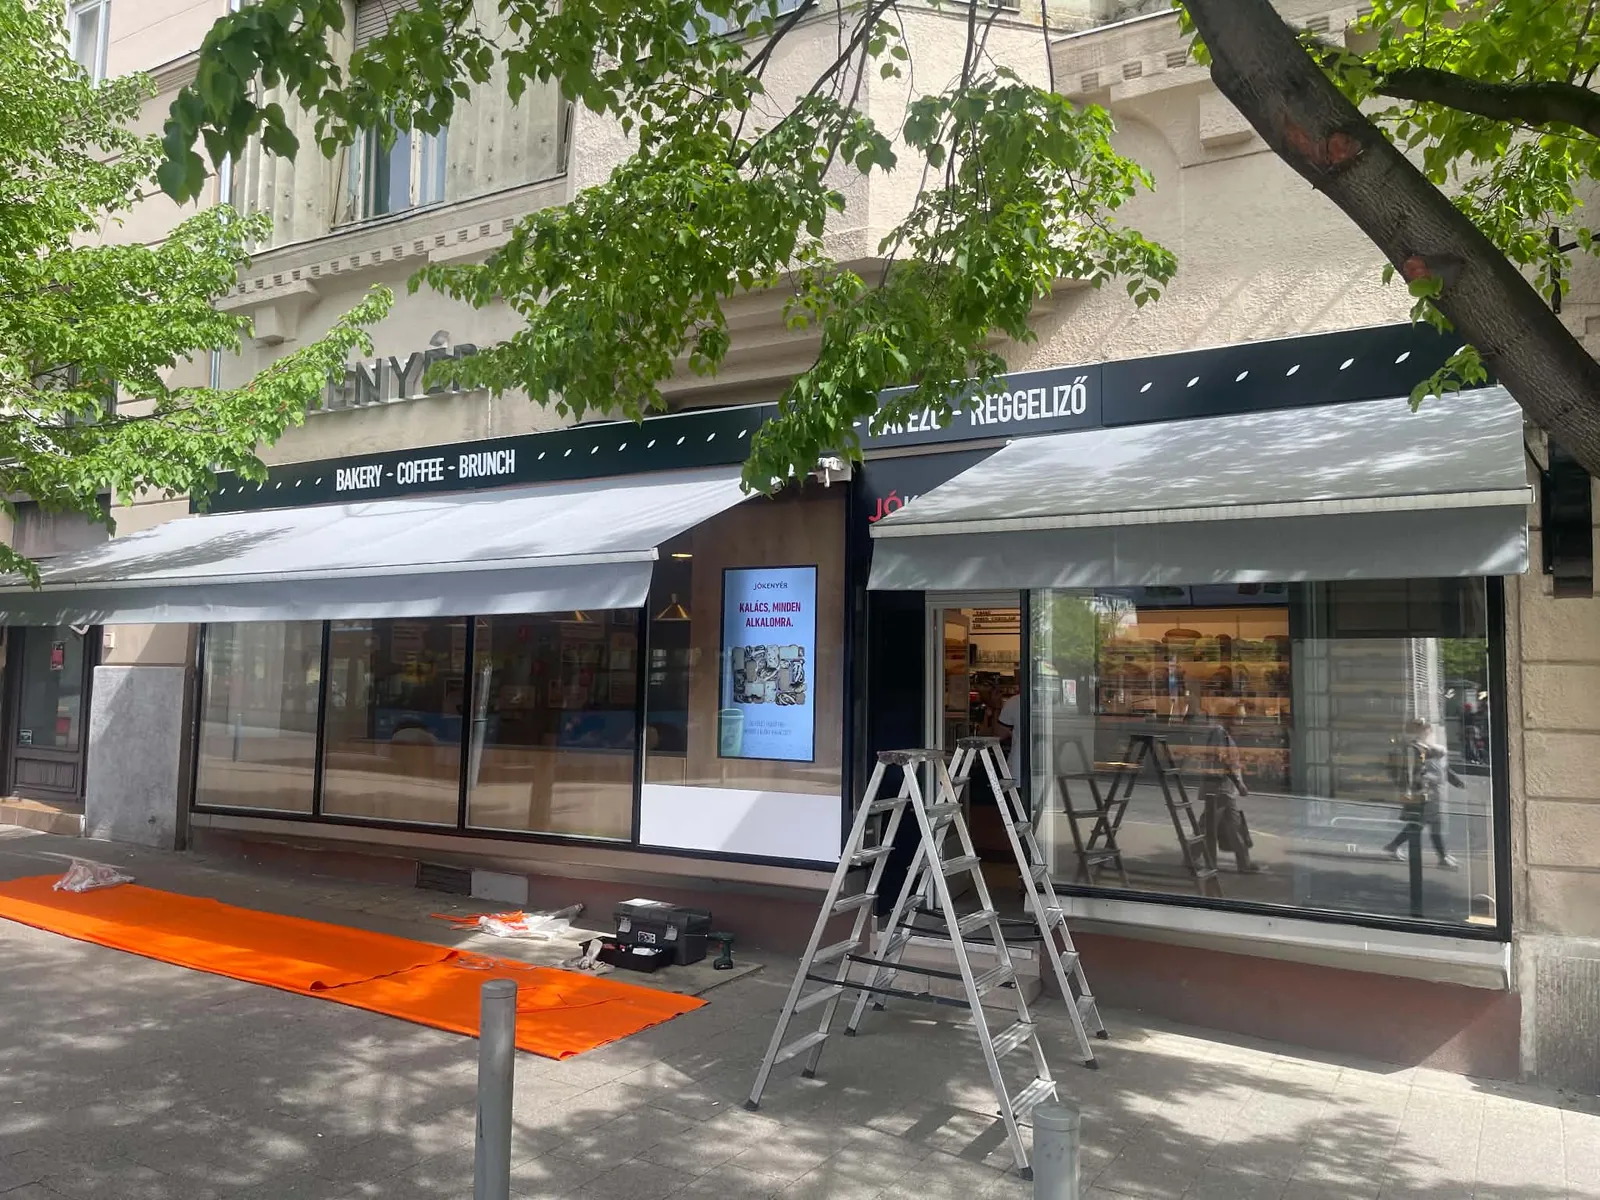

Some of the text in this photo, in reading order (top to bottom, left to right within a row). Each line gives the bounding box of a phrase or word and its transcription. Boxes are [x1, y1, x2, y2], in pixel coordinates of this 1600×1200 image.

[970, 375, 1088, 426] REGGELIZŐ
[336, 449, 515, 491] BAKERY COFFEE BRUNCH
[753, 581, 788, 590] JÓKENYÉR
[739, 600, 801, 613] KALÁCS, MINDEN
[745, 617, 793, 627] ALKALOMRA.
